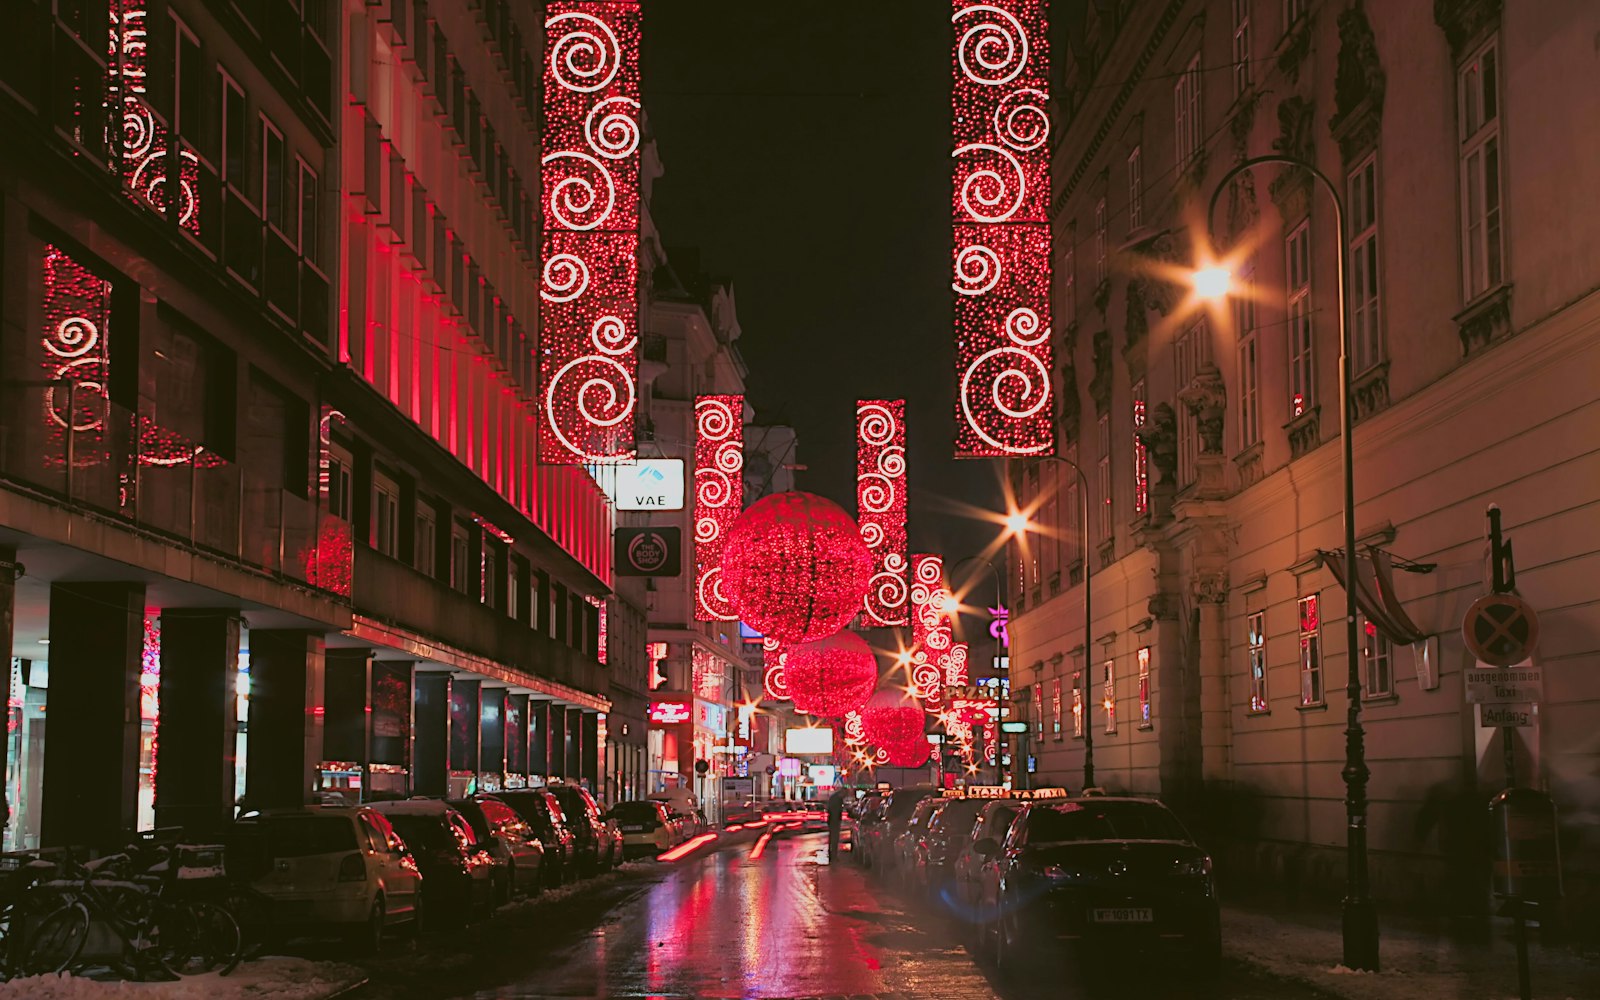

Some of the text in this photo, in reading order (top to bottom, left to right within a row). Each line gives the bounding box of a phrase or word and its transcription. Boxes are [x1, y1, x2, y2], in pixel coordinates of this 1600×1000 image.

[635, 496, 665, 506] VAE
[1468, 671, 1540, 685] ausgenommen
[1494, 685, 1516, 698] Taxi
[1486, 708, 1528, 725] Anfang
[973, 788, 1003, 796] TAXI
[1012, 791, 1040, 799] TAX
[1039, 789, 1062, 798] TAXI
